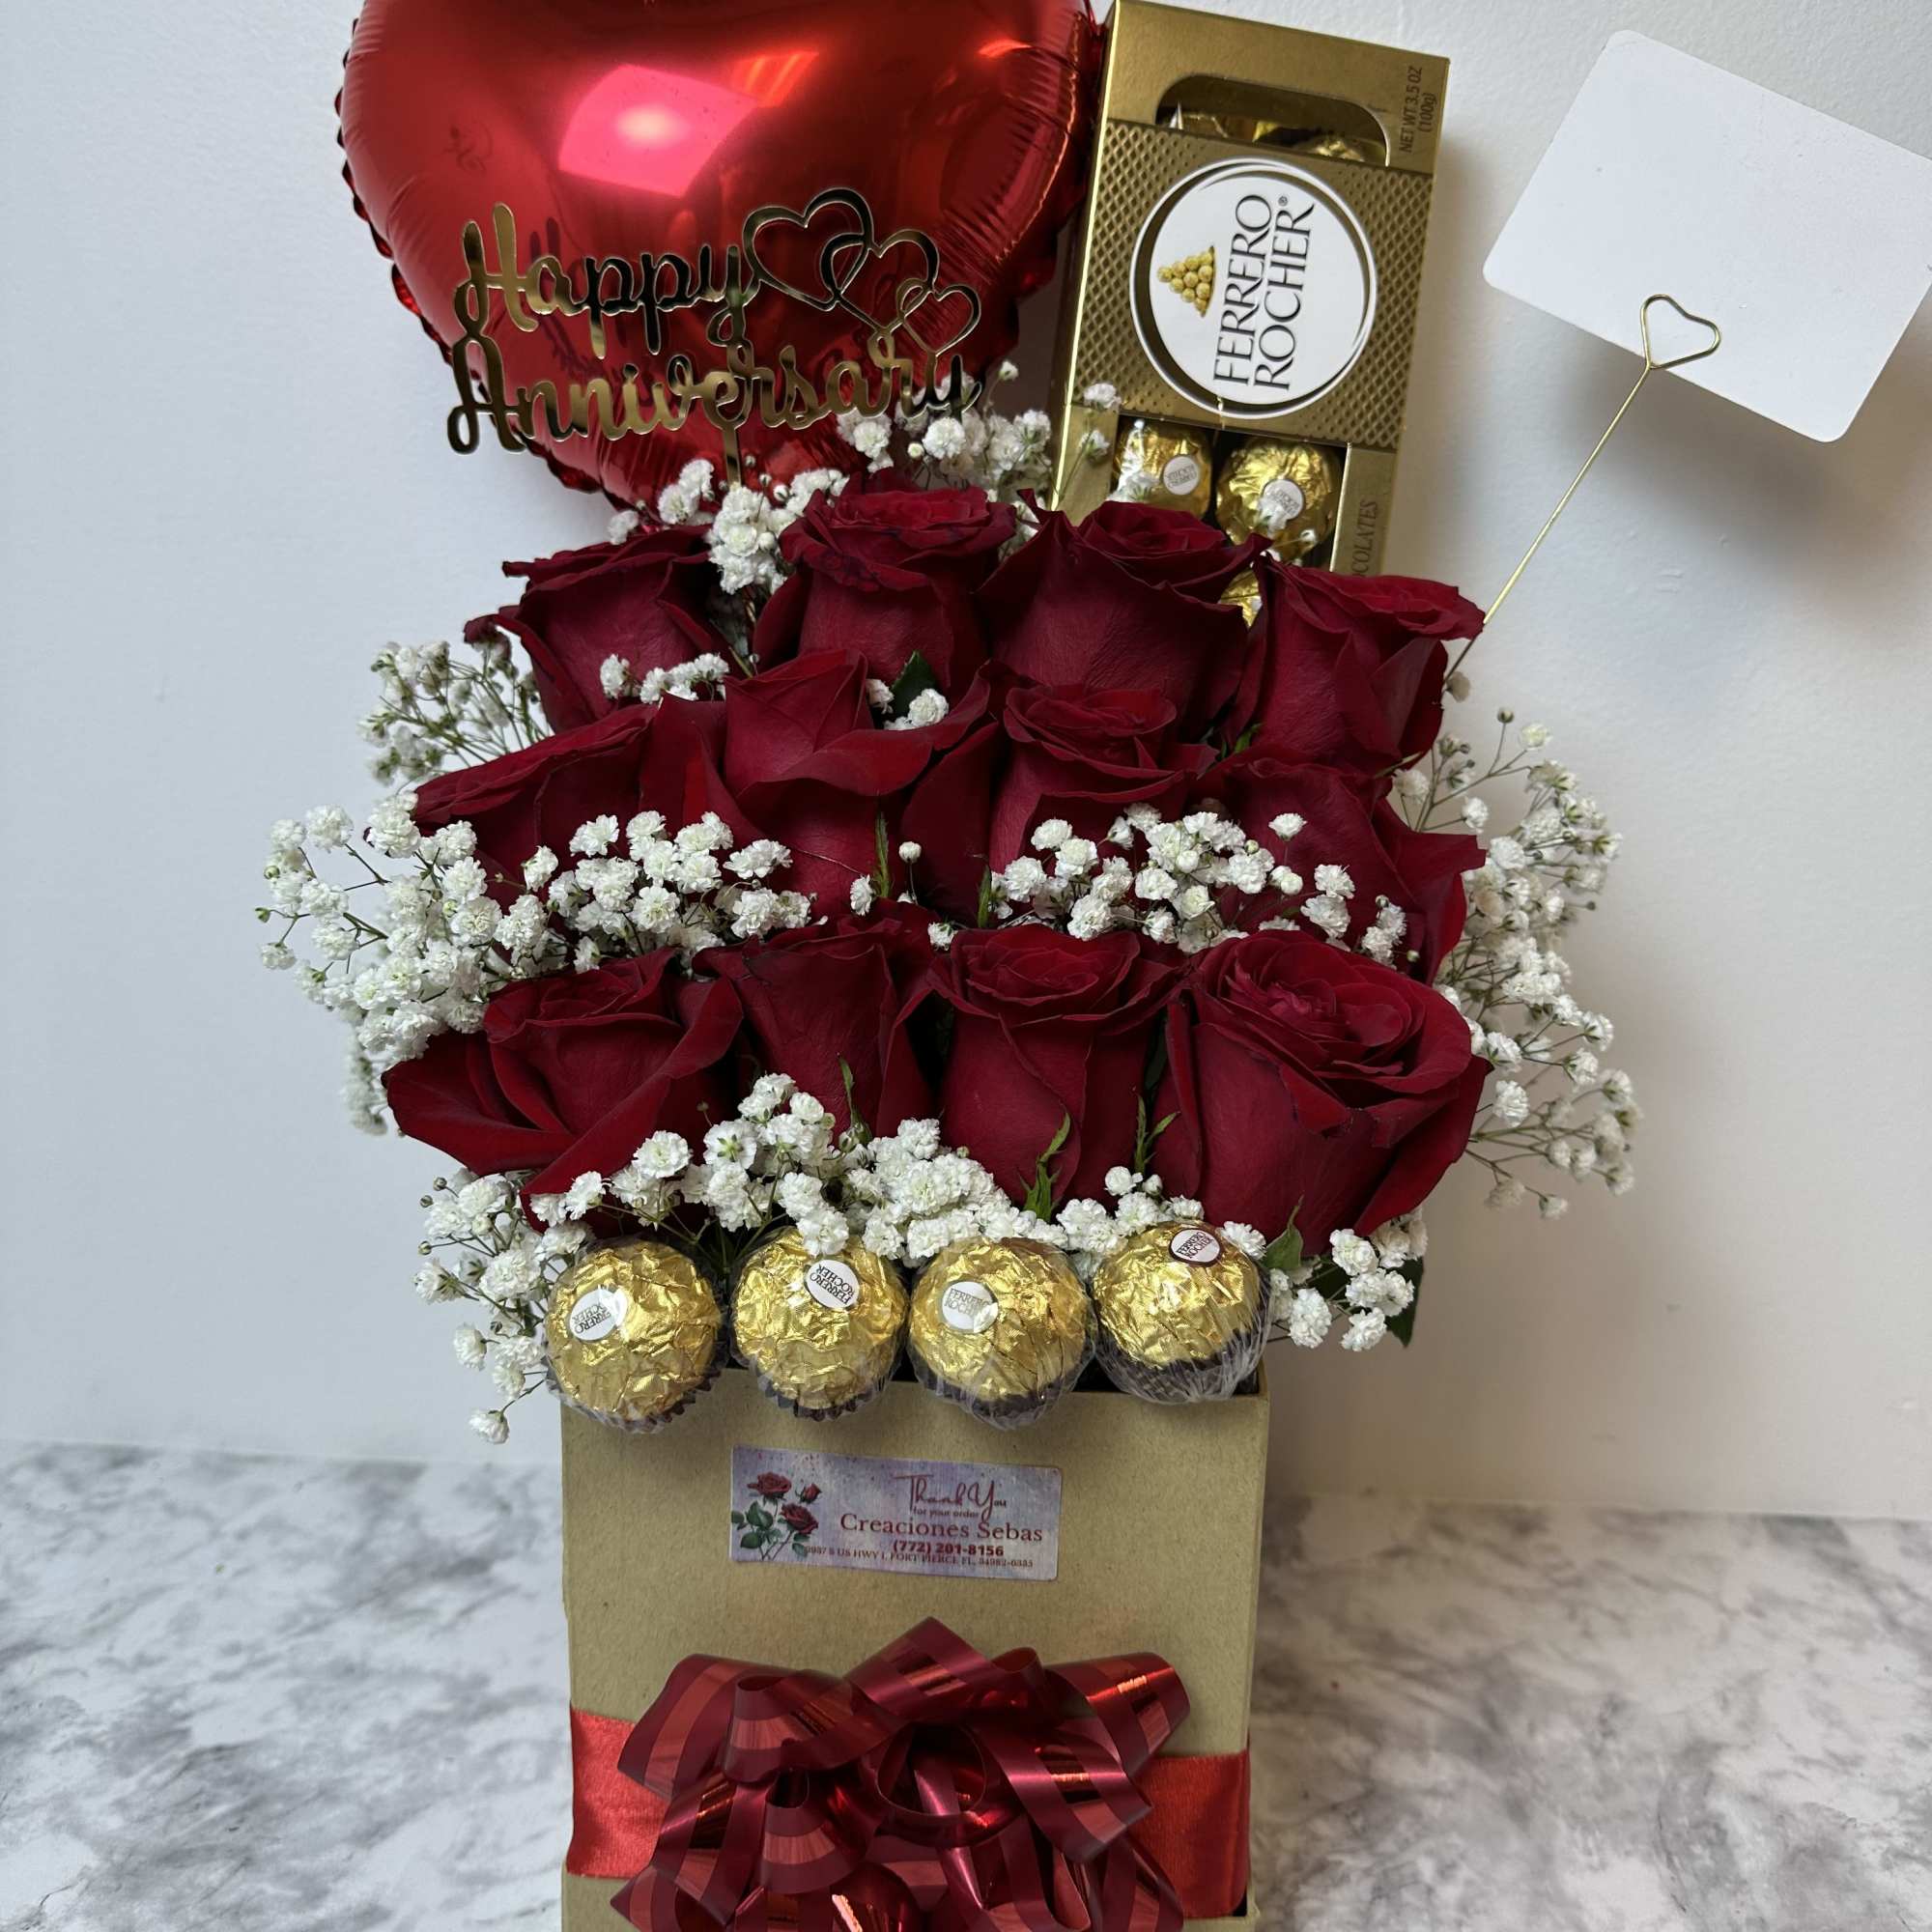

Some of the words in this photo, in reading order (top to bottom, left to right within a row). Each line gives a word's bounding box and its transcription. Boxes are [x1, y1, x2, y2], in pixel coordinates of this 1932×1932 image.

[1407, 65, 1423, 84] OZ
[1402, 106, 1417, 127] WT
[1417, 92, 1438, 133] (100g)
[1399, 128, 1415, 154] NET
[454, 202, 761, 360] Happy
[1213, 194, 1272, 385] FERRERO
[447, 327, 982, 456] Anniversary
[1176, 1230, 1207, 1255] FERRERO
[1185, 1236, 1214, 1259] ROCHER
[810, 1272, 852, 1304] FERRERO
[815, 1264, 855, 1296] ROCHER
[895, 1474, 966, 1512] Thank
[913, 1507, 926, 1516] for
[929, 1509, 950, 1518] your
[840, 1512, 970, 1538] Creaciones
[977, 1520, 1043, 1543] Sebas
[853, 1548, 879, 1560] HWY
[890, 1552, 919, 1562] FORT
[893, 1539, 932, 1554] (772)
[935, 1543, 1004, 1556] 201-8156
